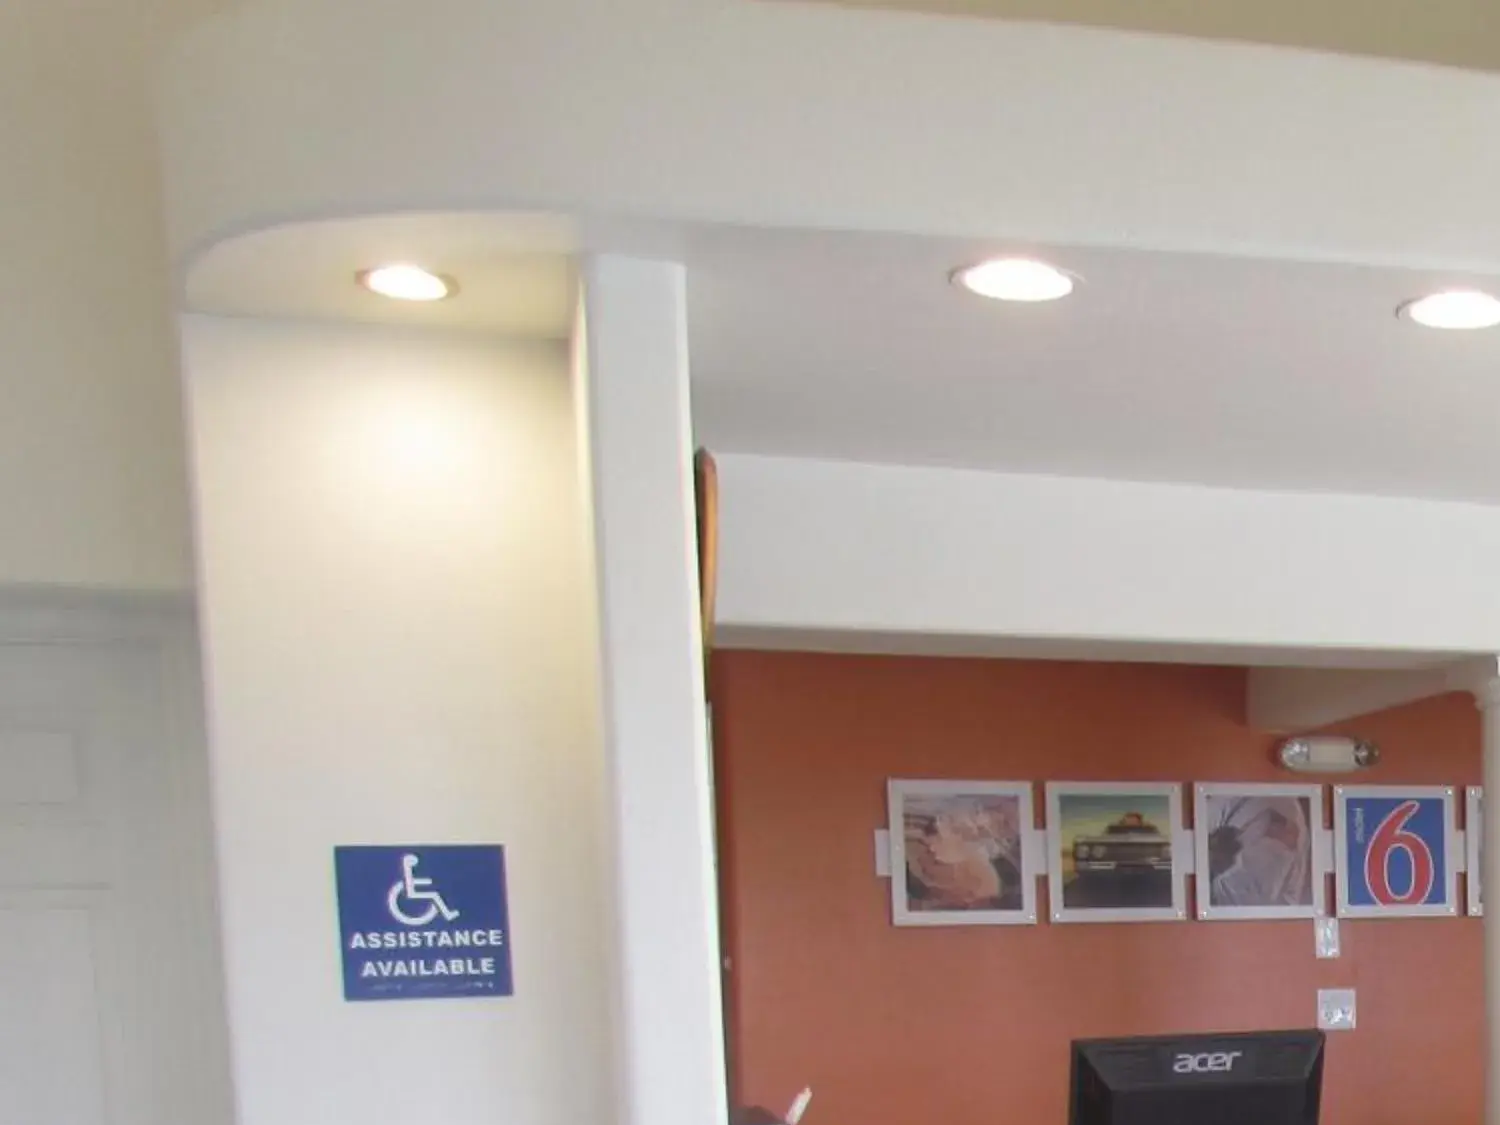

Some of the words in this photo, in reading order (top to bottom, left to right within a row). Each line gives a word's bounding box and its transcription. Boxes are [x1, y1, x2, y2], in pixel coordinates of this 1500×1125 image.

[1364, 801, 1434, 906] 6
[351, 930, 503, 949] ASSISTANCE
[361, 958, 496, 977] AVAILABLE
[1173, 1051, 1242, 1073] acer
